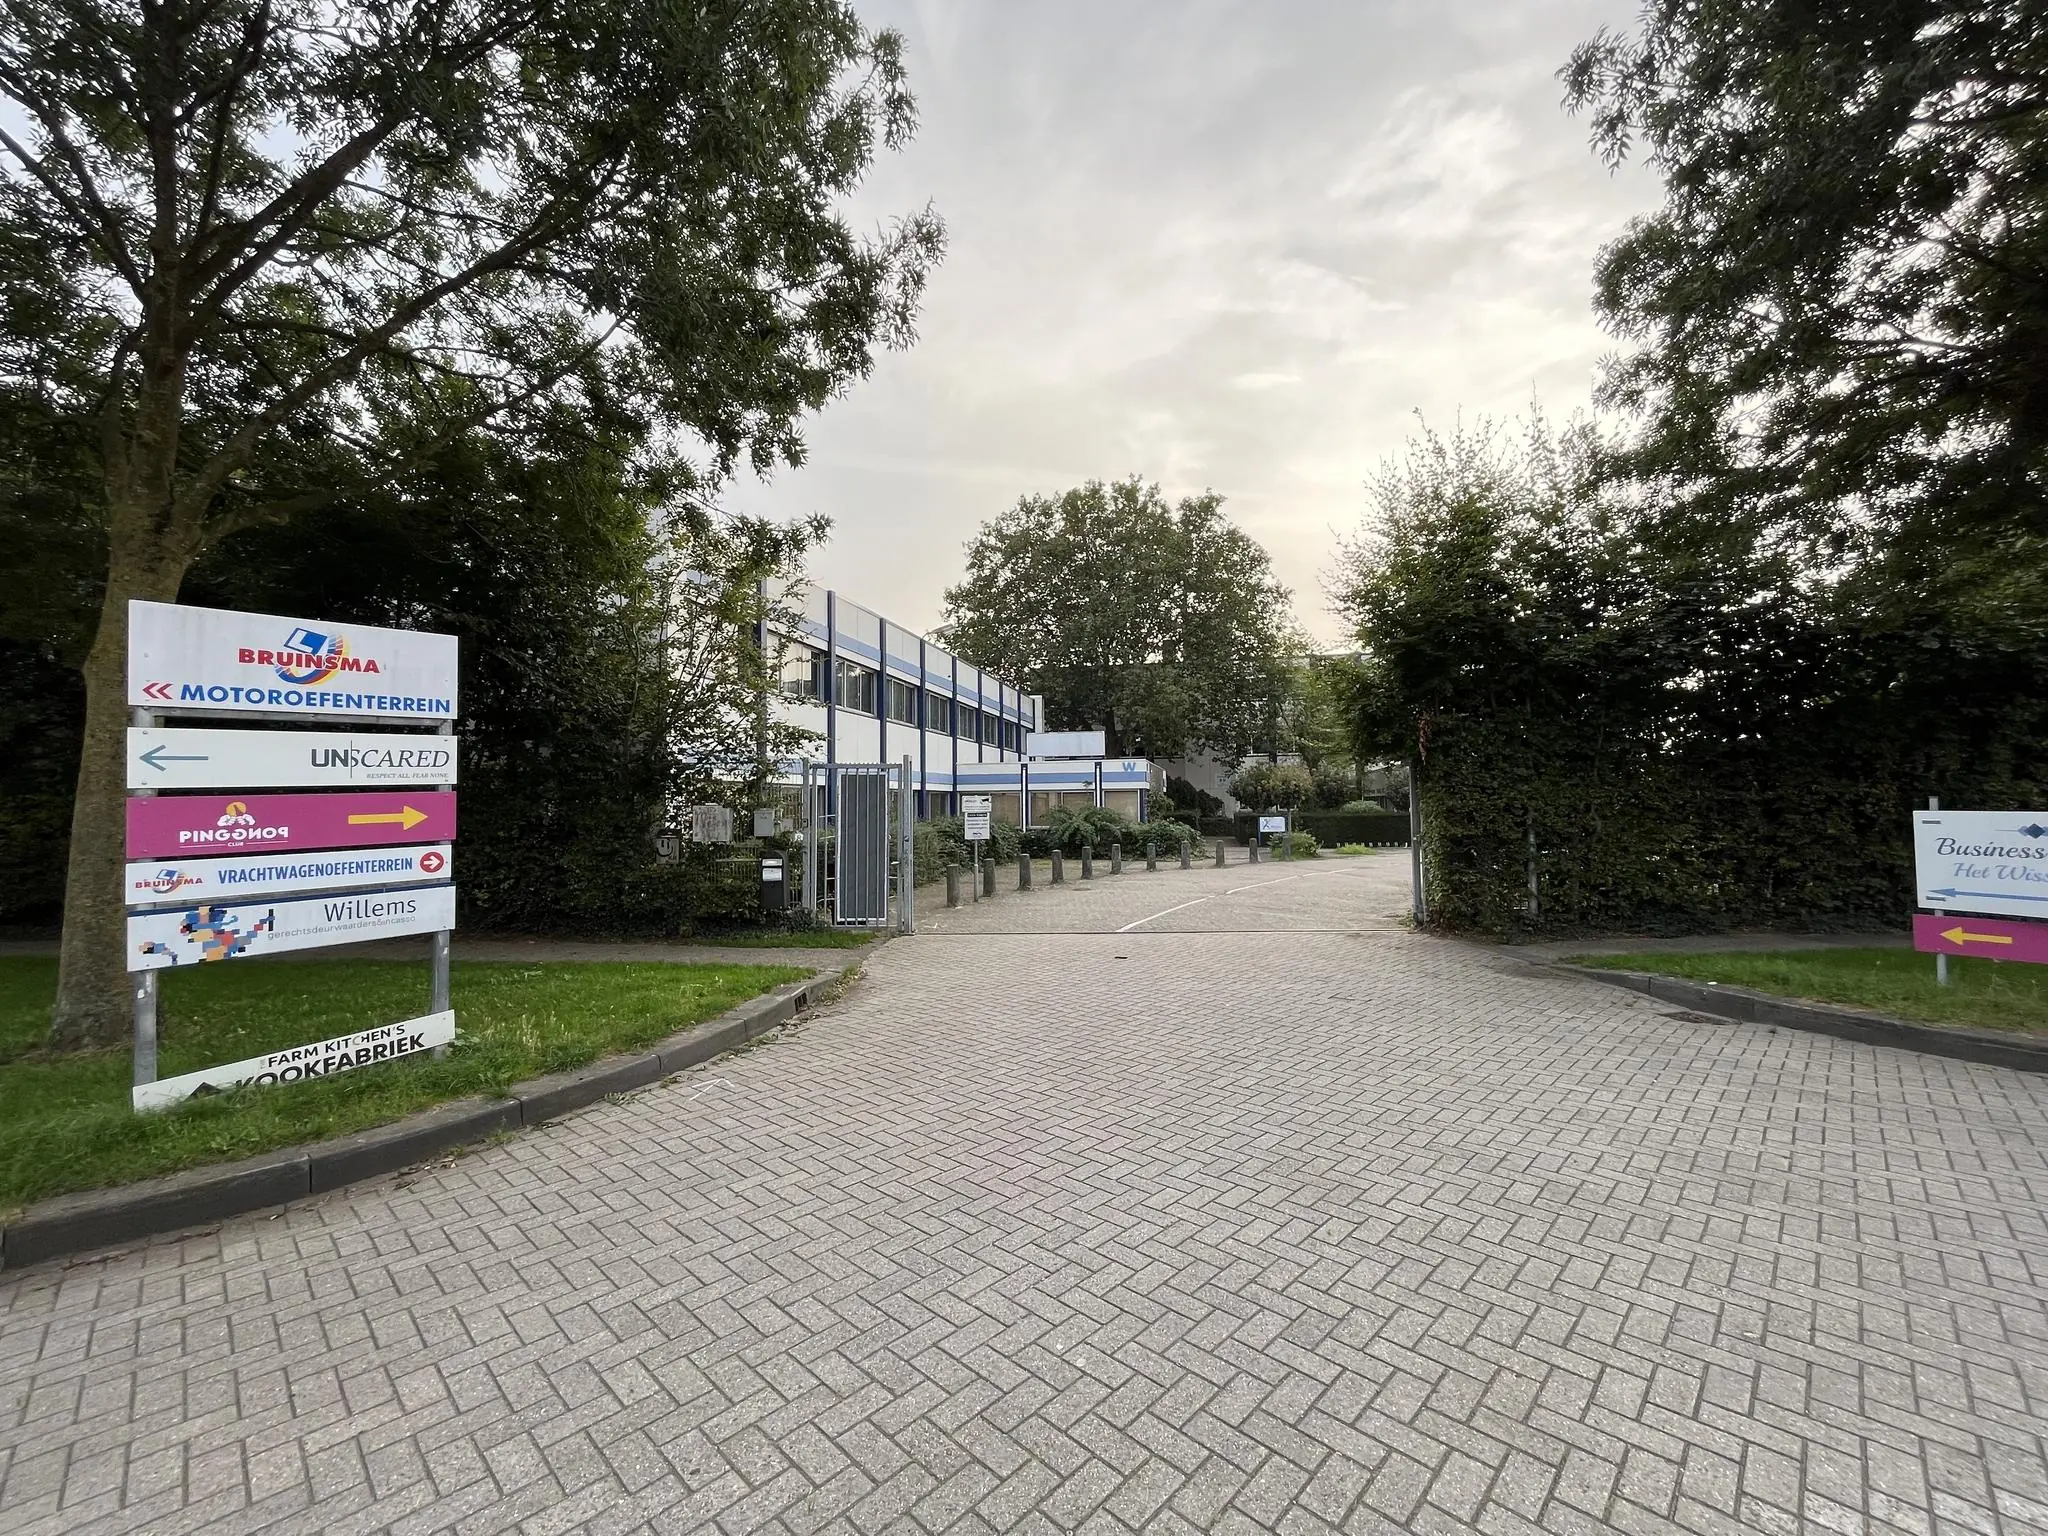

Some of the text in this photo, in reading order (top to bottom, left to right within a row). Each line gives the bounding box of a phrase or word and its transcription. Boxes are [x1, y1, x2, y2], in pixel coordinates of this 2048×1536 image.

[238, 647, 381, 674] BRUINSMA
[179, 683, 451, 714] MOTOROEFENTERREIN
[311, 748, 450, 769] UNSCARED
[1122, 761, 1137, 773] W
[217, 857, 414, 885] VRACHTWAGENOEFENTERREIN
[1954, 862, 1991, 880] Het
[324, 897, 418, 923] Willems
[268, 1045, 319, 1068] FARM
[325, 1023, 406, 1054] KITCHEN'S
